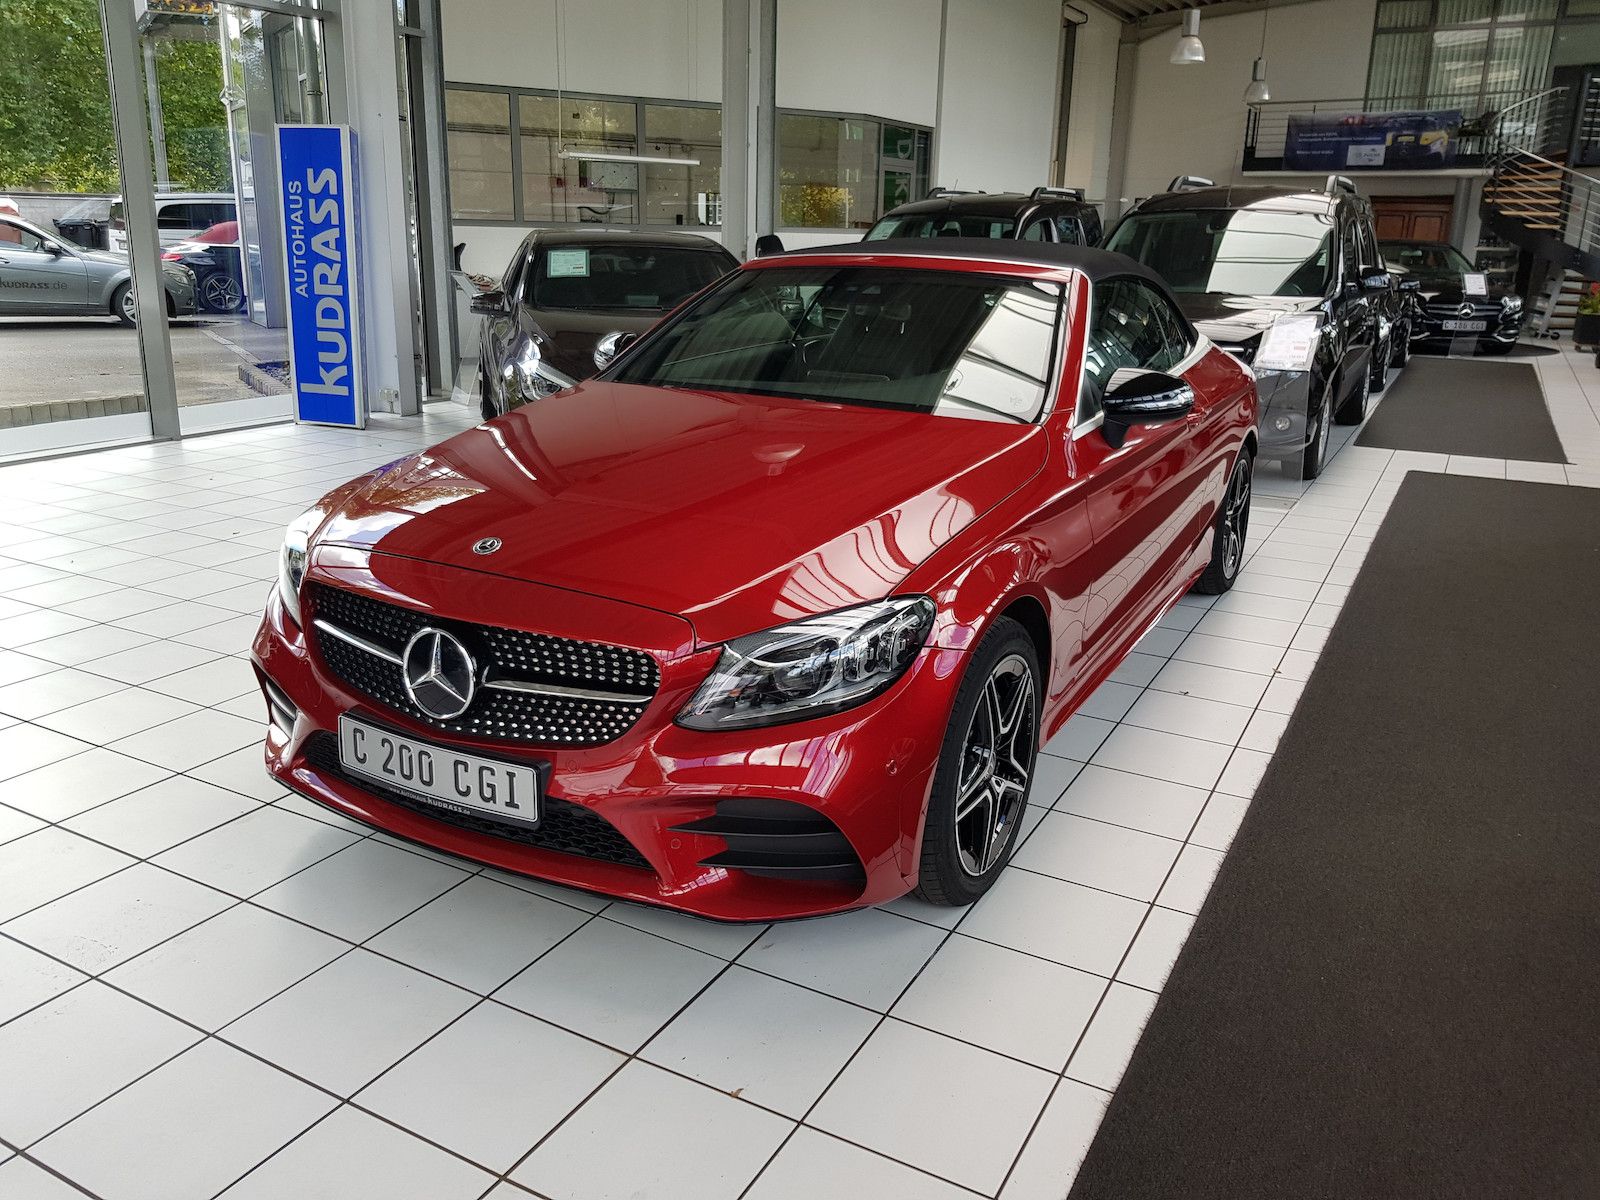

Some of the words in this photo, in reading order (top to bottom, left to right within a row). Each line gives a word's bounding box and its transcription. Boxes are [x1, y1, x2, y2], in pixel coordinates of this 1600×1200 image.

[288, 180, 308, 298] AUTOHAUS
[353, 727, 367, 764] C
[381, 738, 433, 786] 200
[453, 759, 520, 810] CGI
